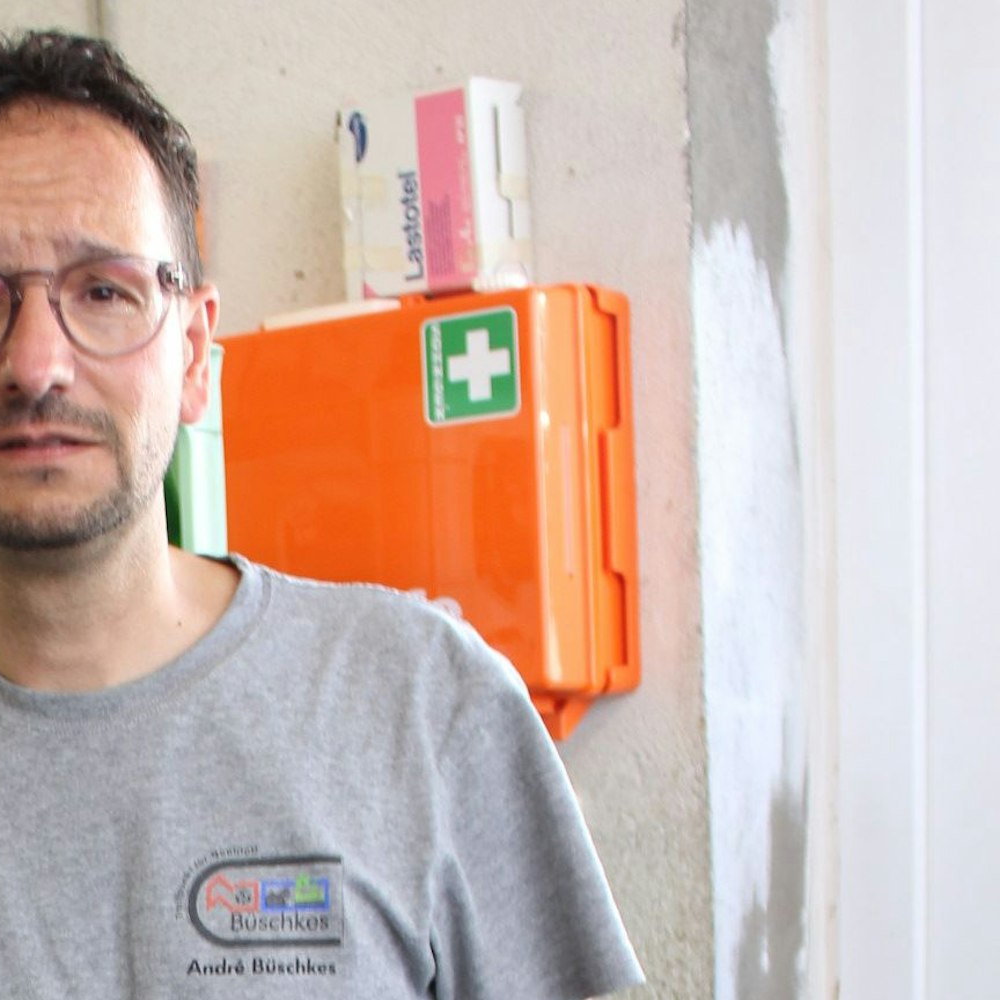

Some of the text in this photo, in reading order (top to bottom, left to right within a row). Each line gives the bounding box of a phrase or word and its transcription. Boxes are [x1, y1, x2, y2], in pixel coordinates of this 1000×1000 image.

[398, 171, 424, 281] Lastotel
[186, 956, 336, 976] André Büschkes
